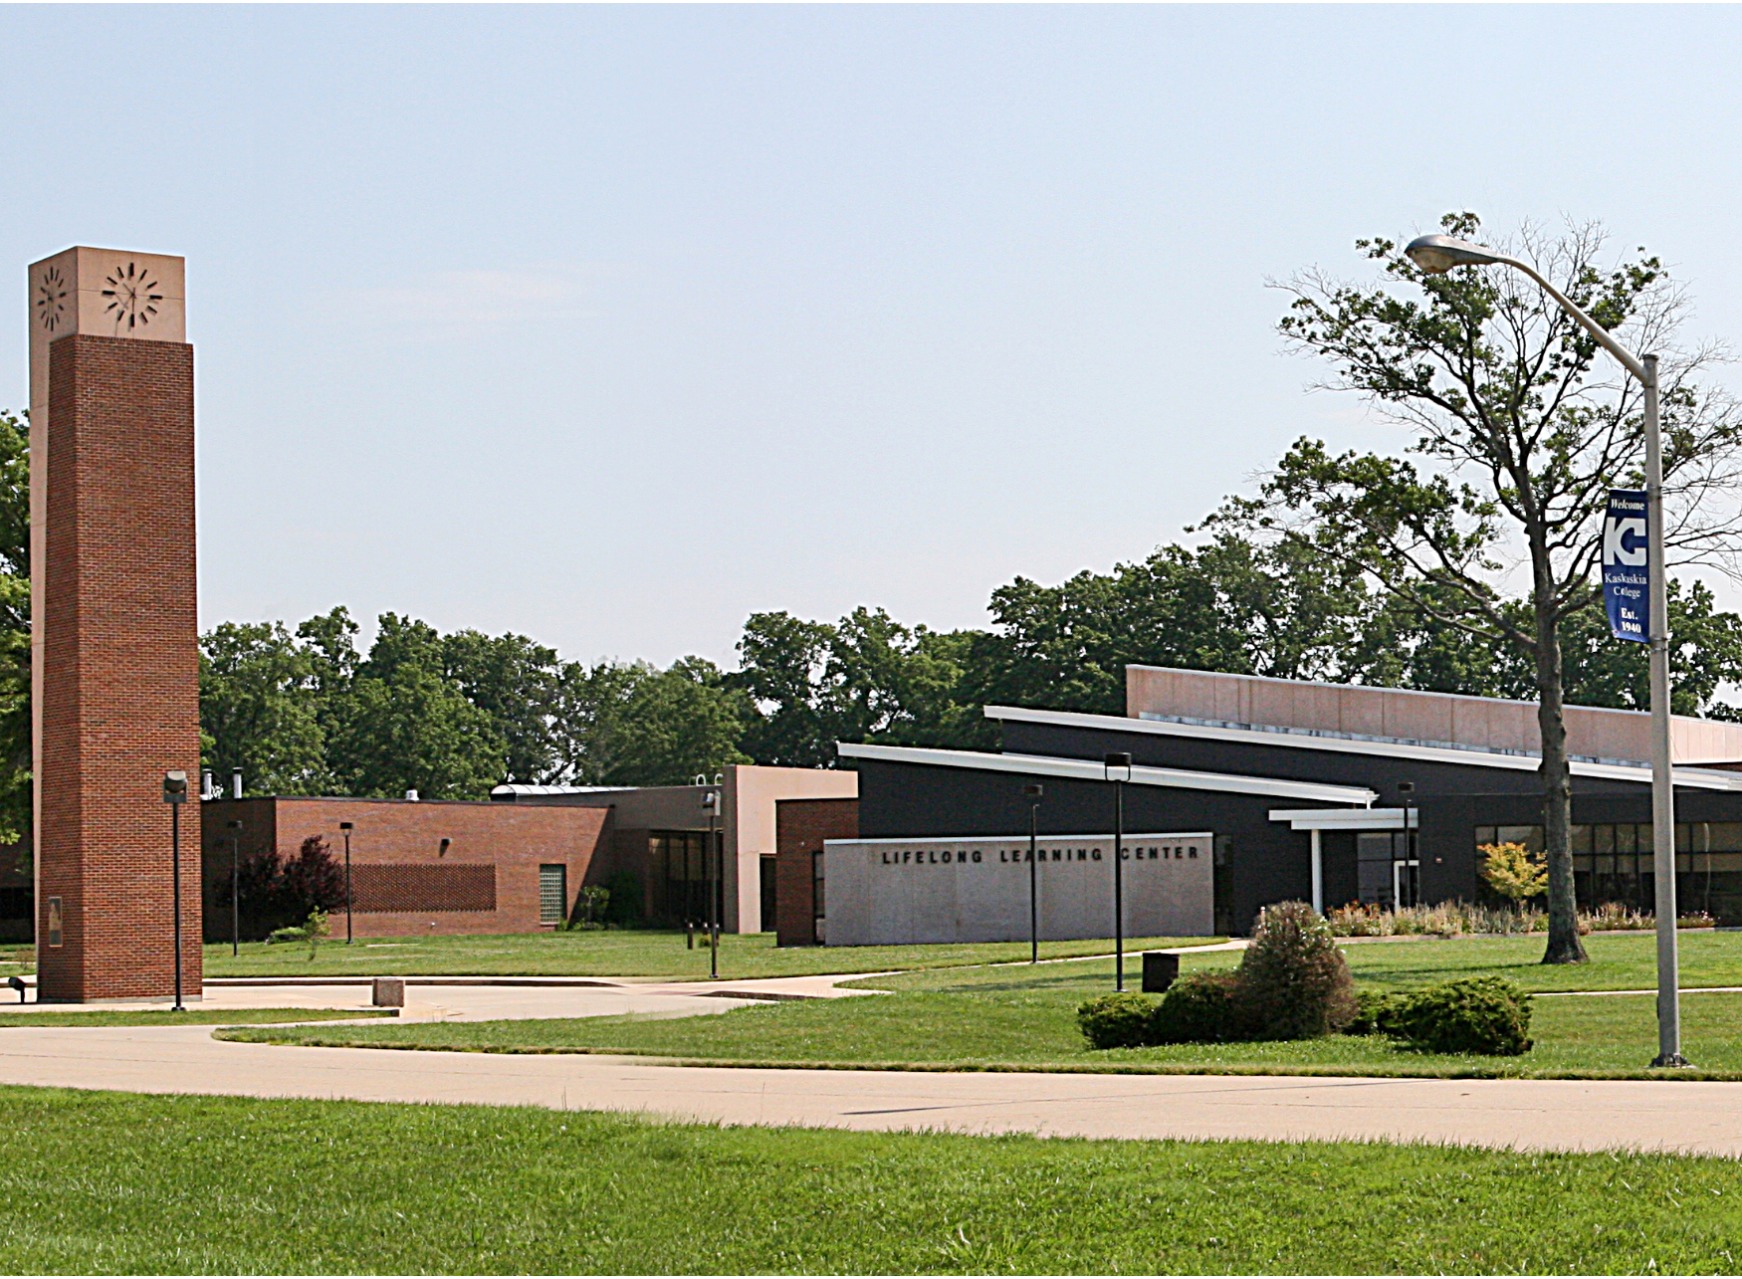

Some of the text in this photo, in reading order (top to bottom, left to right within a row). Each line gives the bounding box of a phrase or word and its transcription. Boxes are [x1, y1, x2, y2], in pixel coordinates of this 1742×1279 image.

[1611, 498, 1645, 510] Welcome
[1603, 516, 1647, 566] KC
[1621, 607, 1639, 620] Est.
[1621, 621, 1642, 633] 1940
[882, 846, 1198, 864] LIFELONG LEARNING CENTER
